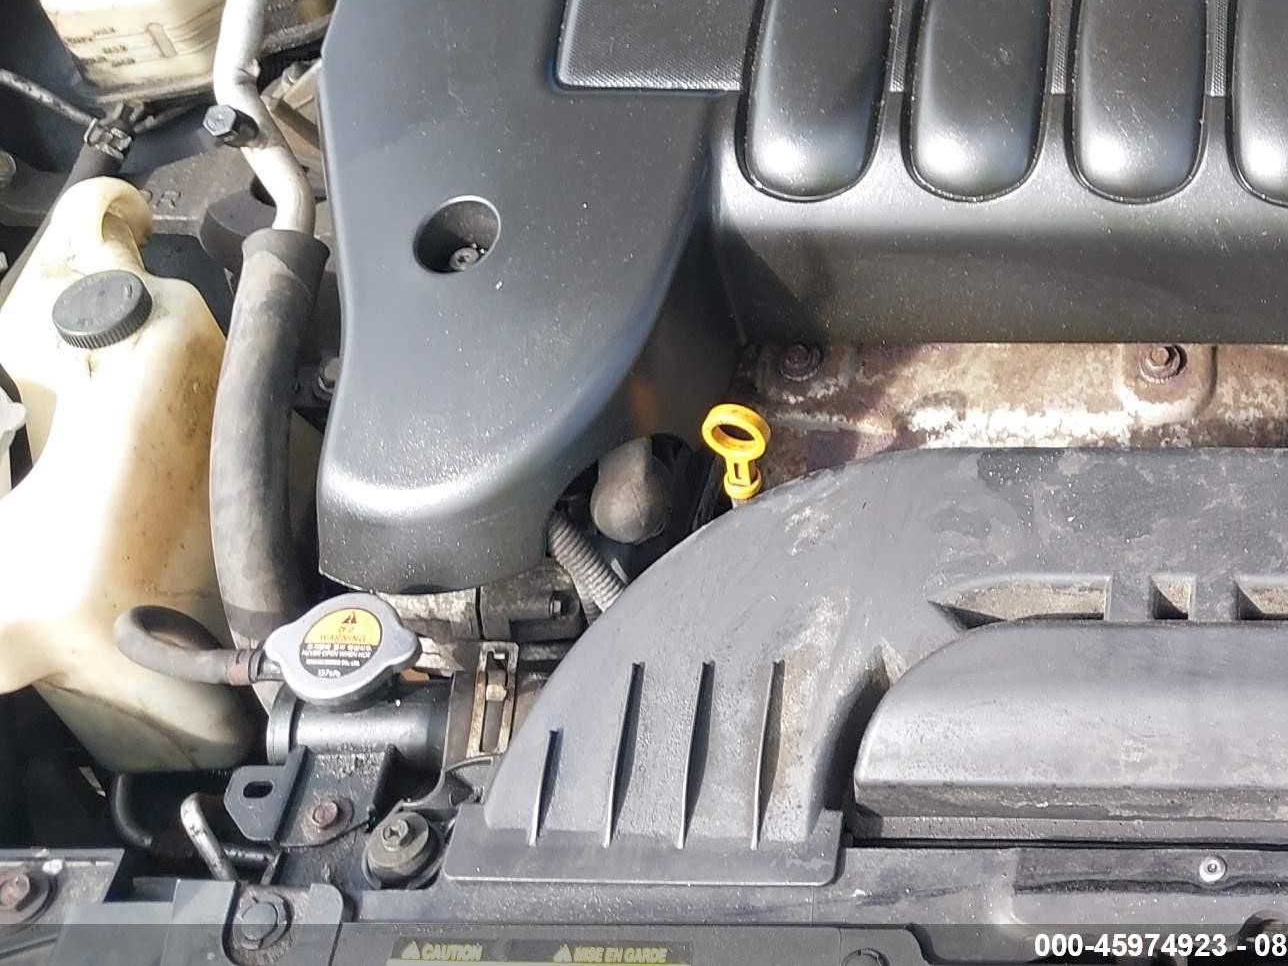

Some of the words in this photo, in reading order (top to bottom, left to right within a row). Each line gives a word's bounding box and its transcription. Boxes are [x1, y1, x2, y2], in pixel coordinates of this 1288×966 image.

[320, 634, 367, 643] WARNING
[322, 650, 339, 658] OPEN
[339, 650, 358, 658] WHEN
[422, 944, 482, 961] CAUTION
[605, 948, 622, 962] EN
[624, 948, 668, 963] GARDE
